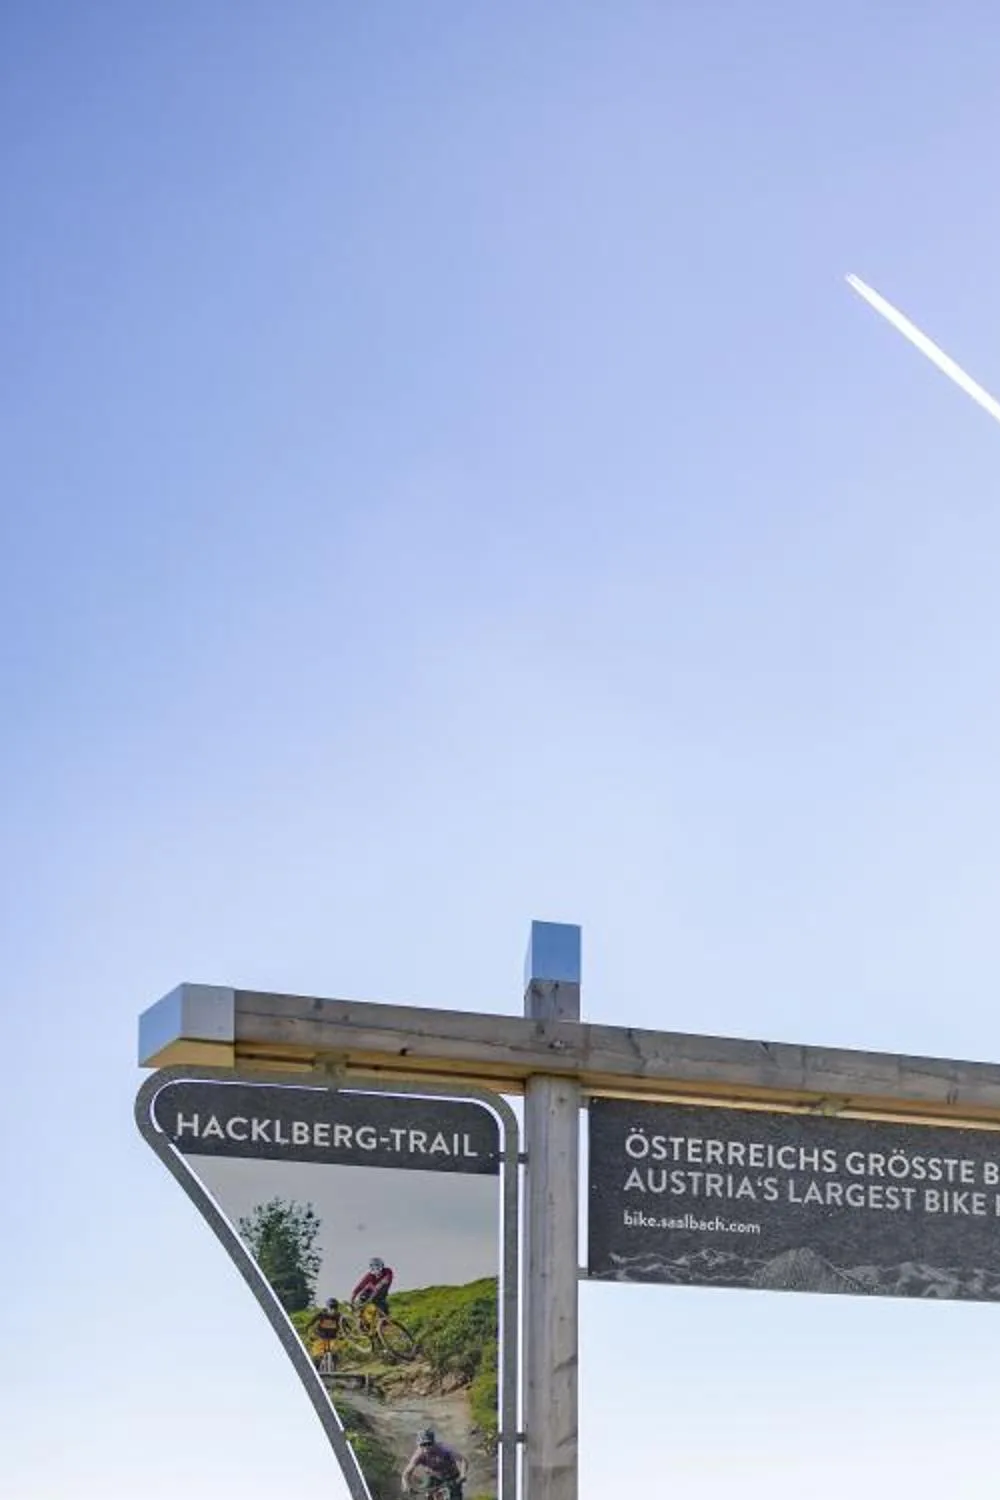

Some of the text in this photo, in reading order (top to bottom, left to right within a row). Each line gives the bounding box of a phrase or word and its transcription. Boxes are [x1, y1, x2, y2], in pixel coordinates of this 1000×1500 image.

[176, 1112, 478, 1158] HACKLBERG-TRAIL
[625, 1127, 837, 1173] ÖSTERREICHS
[845, 1148, 975, 1184] GRÖSSTE
[623, 1167, 779, 1201] AUSTRIA'S
[789, 1179, 917, 1210] LARGEST
[925, 1188, 987, 1216] BIKE
[623, 1209, 761, 1235] bike.saalbach.com
